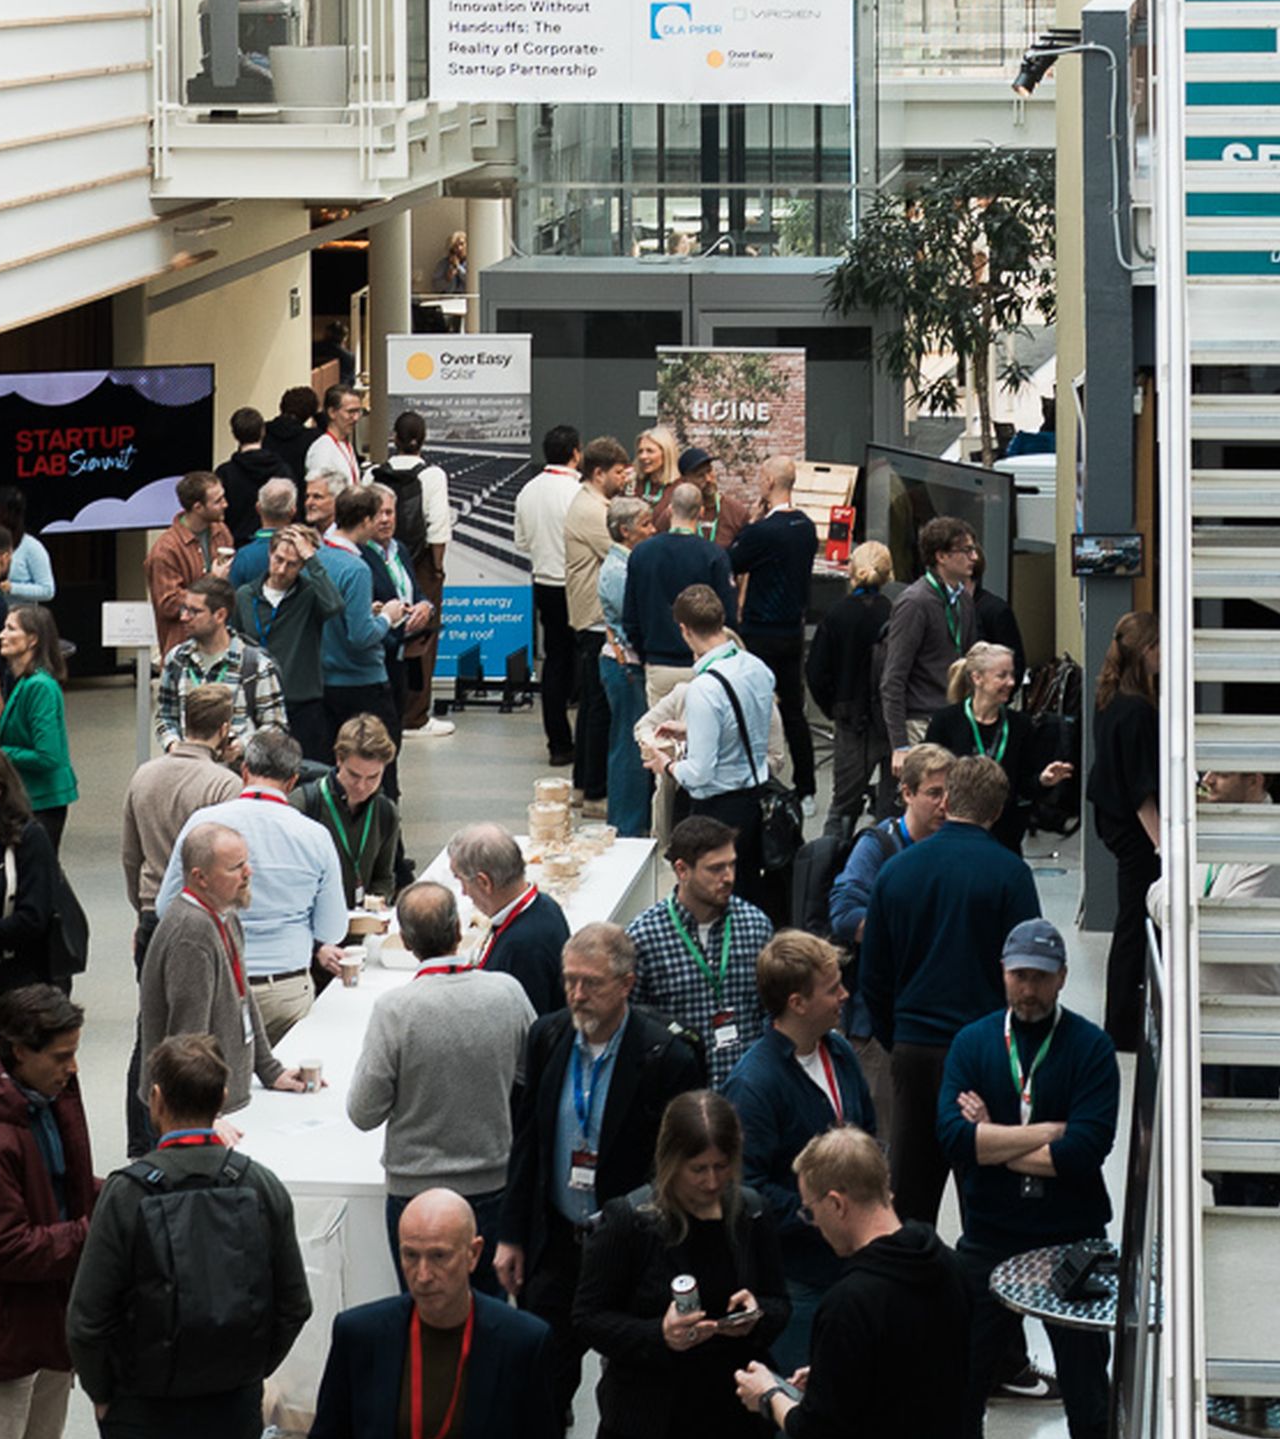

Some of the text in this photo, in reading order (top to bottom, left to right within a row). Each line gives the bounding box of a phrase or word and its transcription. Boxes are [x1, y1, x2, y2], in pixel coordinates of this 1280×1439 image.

[448, 0, 591, 13] Innovation Without
[448, 20, 562, 34] Handcuffs: The
[688, 24, 722, 35] PIPER
[448, 41, 604, 57] Reality of Corporate-
[448, 62, 598, 78] Startup Partnership
[15, 424, 136, 453] STARTUP
[17, 443, 139, 478] LAB Summit
[473, 597, 513, 609] energy
[464, 612, 486, 623] and
[488, 612, 524, 623] better
[448, 629, 468, 640] the
